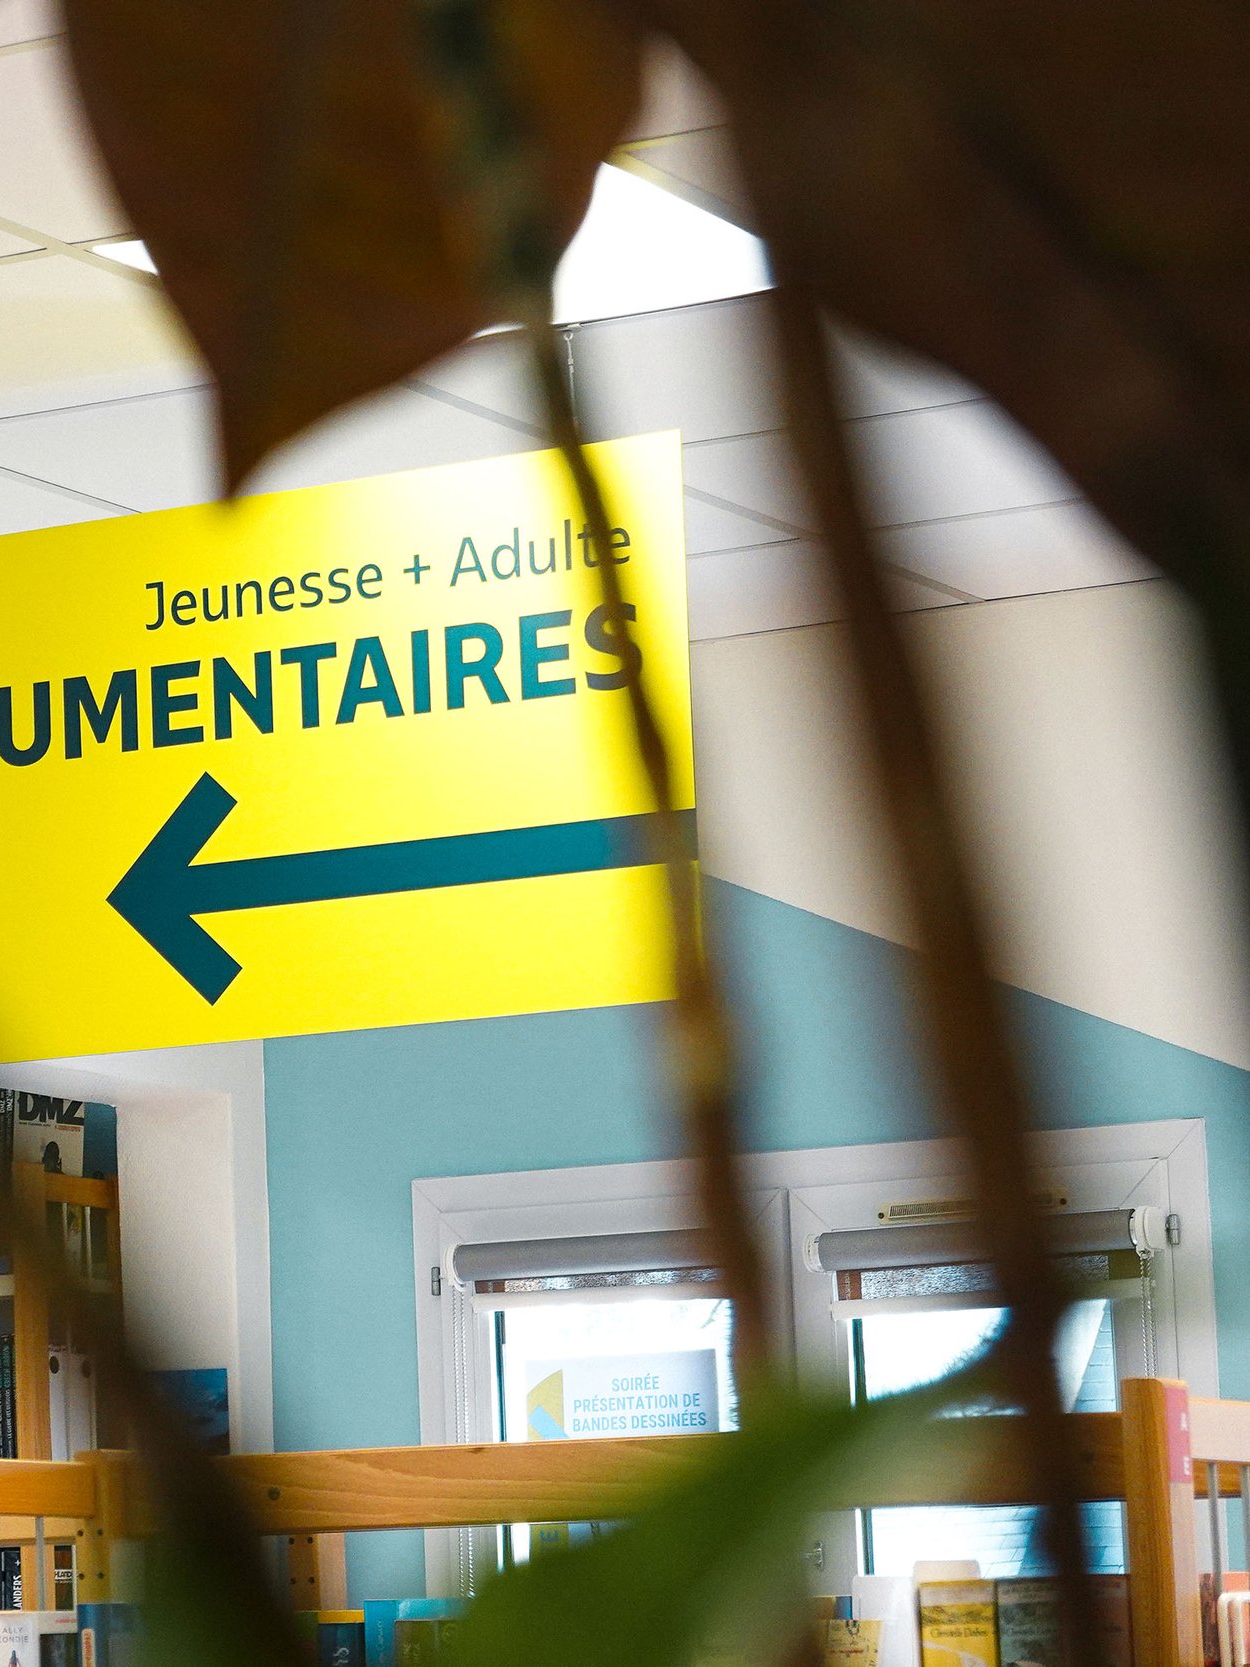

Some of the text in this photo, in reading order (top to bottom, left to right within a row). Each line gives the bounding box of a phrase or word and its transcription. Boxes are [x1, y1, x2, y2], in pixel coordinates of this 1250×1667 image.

[145, 519, 632, 631] Jeunesse + Adulte
[18, 1091, 85, 1126] DMZ
[611, 1373, 660, 1392] SOIRÉE
[573, 1393, 701, 1413] PRÉSENTATION DE
[572, 1409, 707, 1432] BANDES DESSINÉES
[2, 1626, 23, 1634] ALLY
